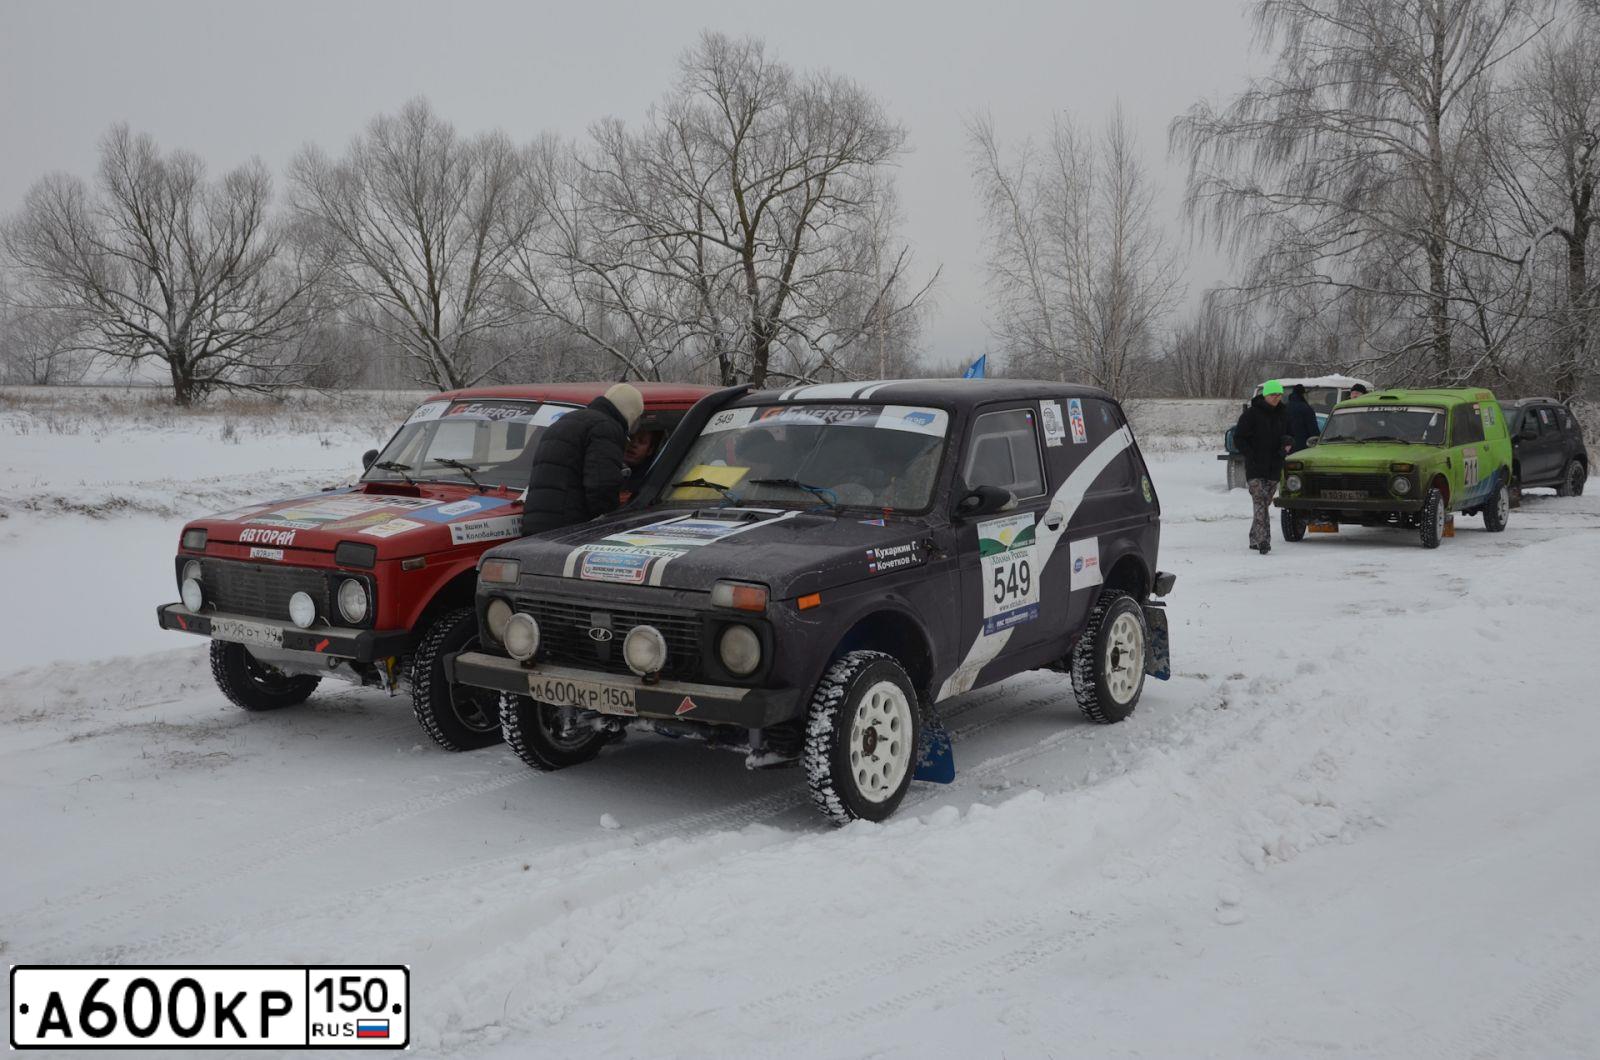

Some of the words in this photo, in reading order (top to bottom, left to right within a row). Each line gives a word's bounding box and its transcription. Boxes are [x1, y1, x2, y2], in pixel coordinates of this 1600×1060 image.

[714, 413, 735, 426] 549
[239, 529, 296, 545] АВТОРАЙ
[874, 544, 911, 559] Кухаркин
[877, 556, 910, 570] Кочетков
[993, 560, 1031, 604] 549
[536, 681, 598, 707] А600КР
[602, 688, 630, 706] 150
